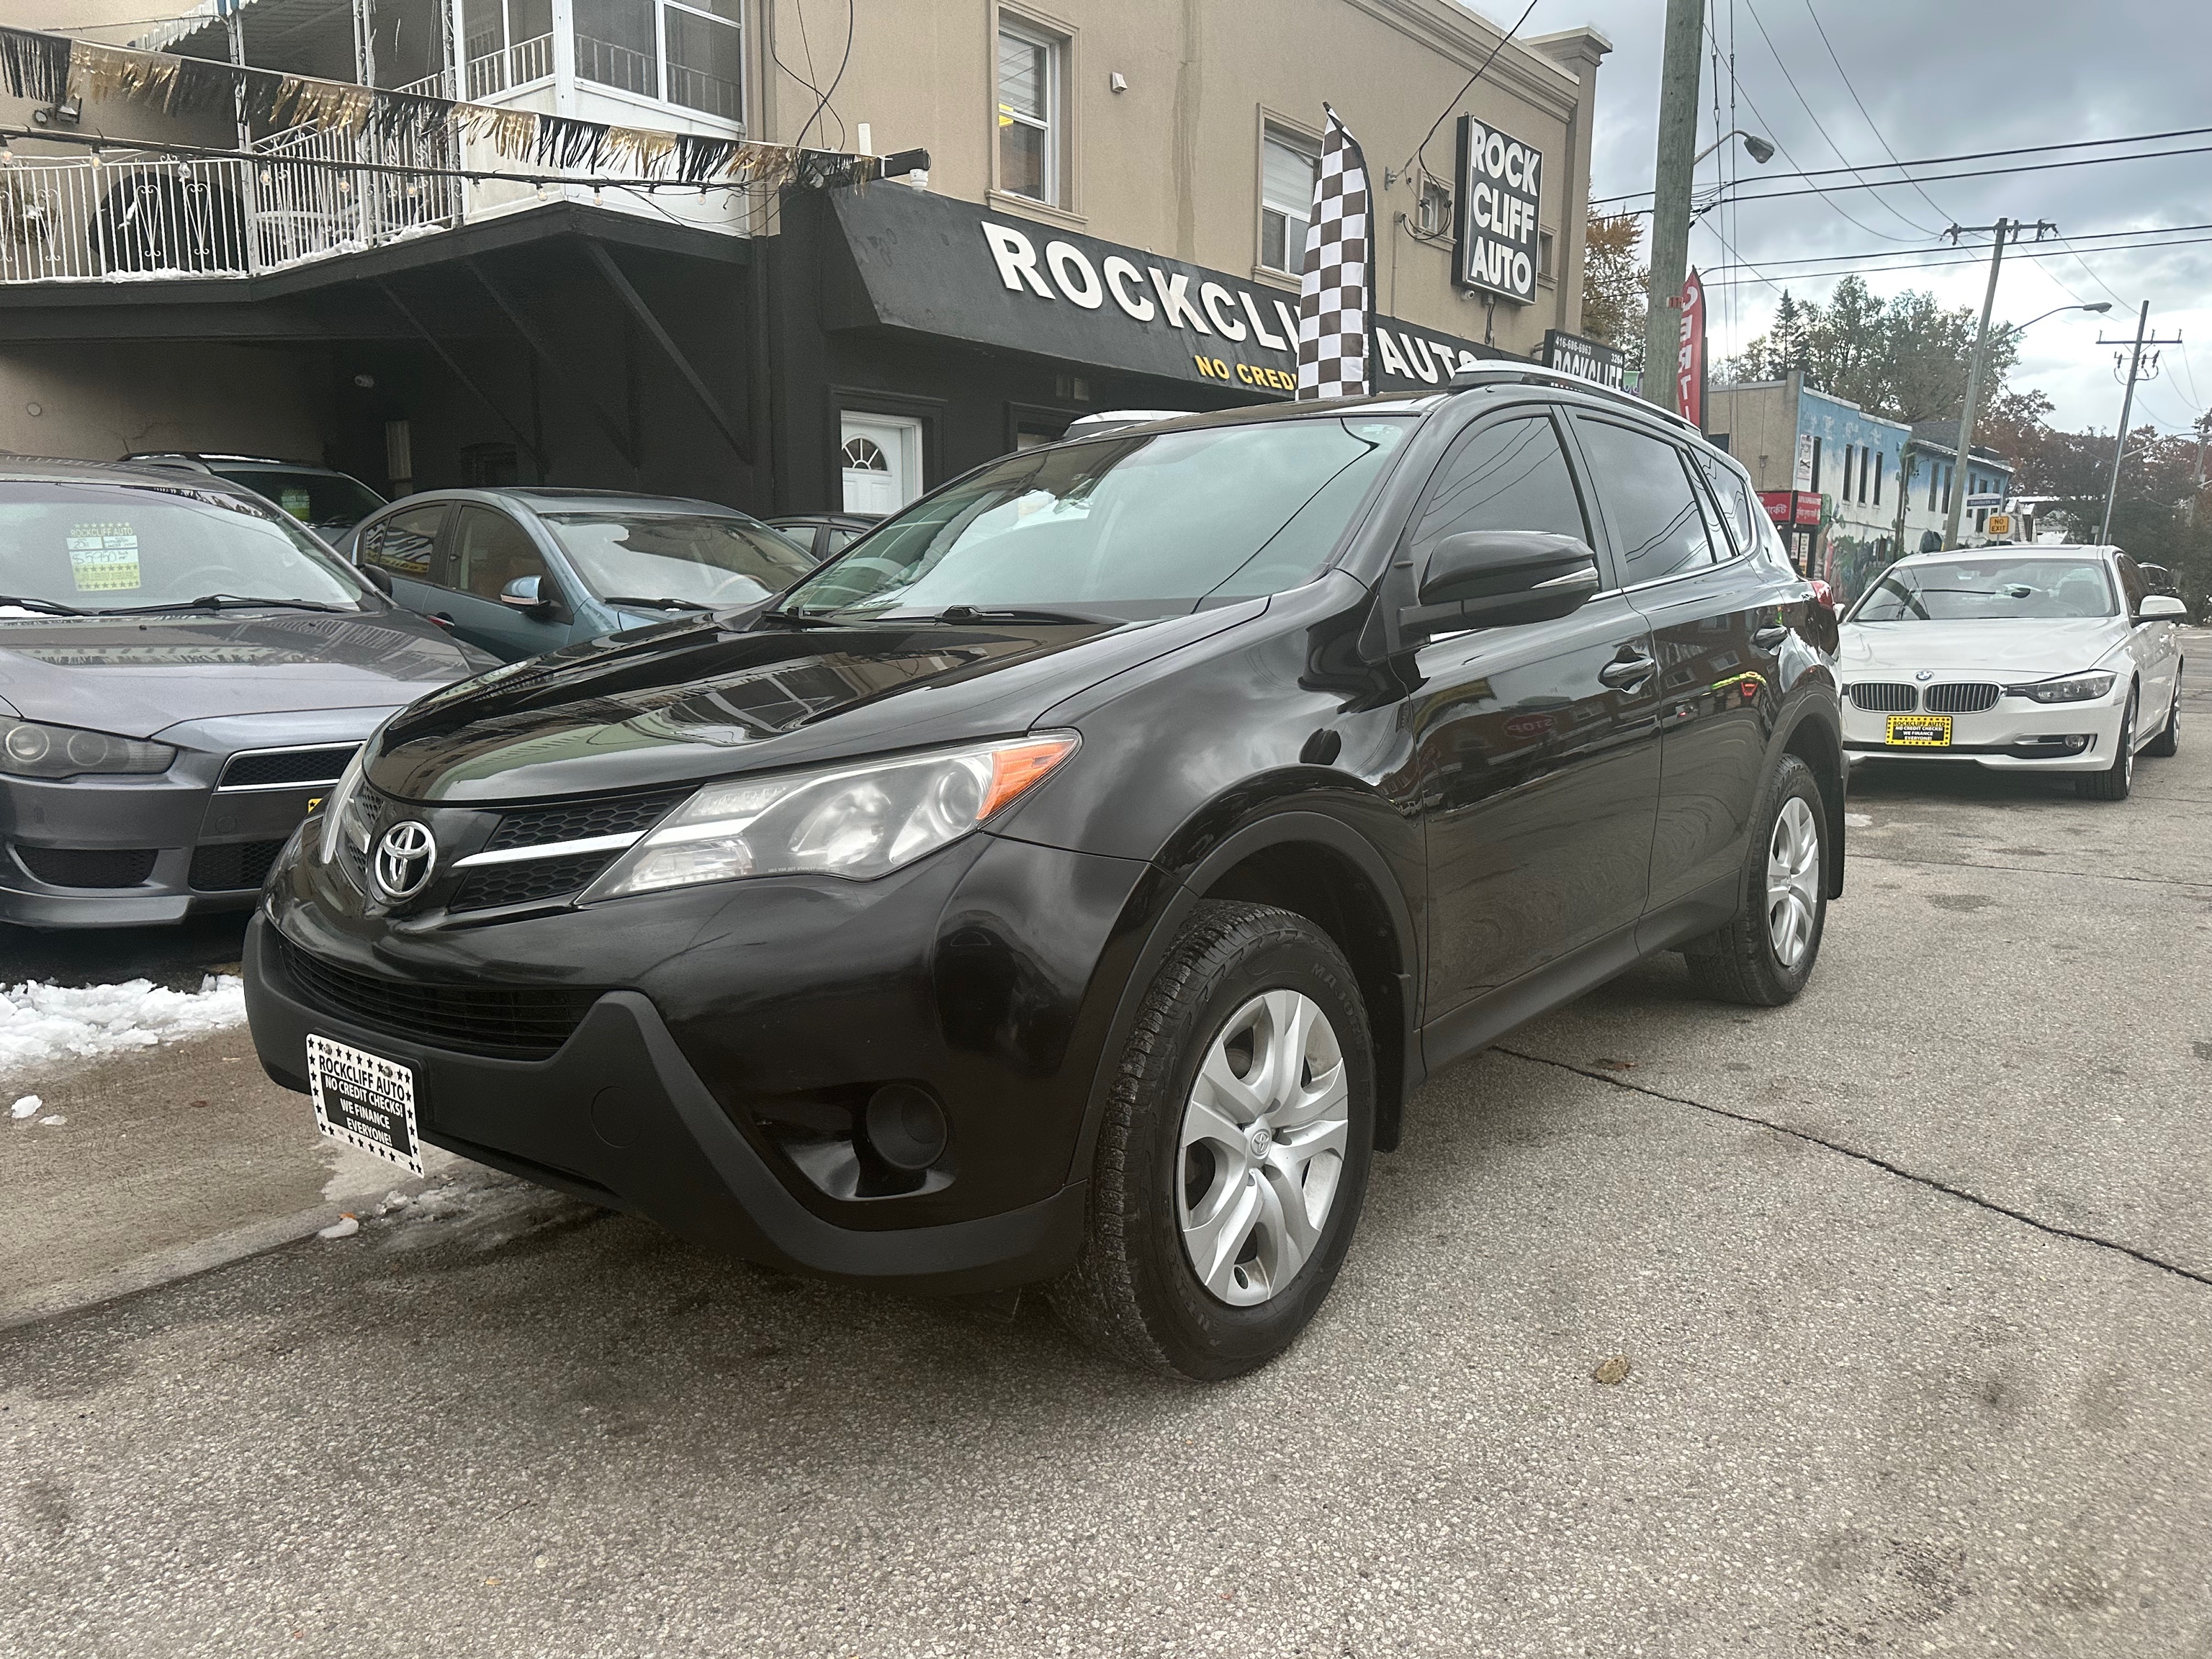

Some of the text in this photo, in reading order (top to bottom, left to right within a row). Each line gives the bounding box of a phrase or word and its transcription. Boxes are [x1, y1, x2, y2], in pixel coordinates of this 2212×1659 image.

[1472, 121, 1539, 197] ROCK
[1473, 183, 1534, 244] CLIFF
[1470, 235, 1532, 295] AUTO
[980, 220, 1300, 354] ROCKCLI
[1194, 355, 1230, 379] NO
[1611, 353, 1623, 365] 3264
[71, 527, 133, 537] ROCKCLIFF AUTO
[319, 1055, 405, 1102] ROCKCLIFF AUTO
[325, 1076, 404, 1118] NO CREDIT CHECKS!
[340, 1097, 391, 1130] WE FINANCE
[346, 1117, 393, 1146] EVERYONE!
